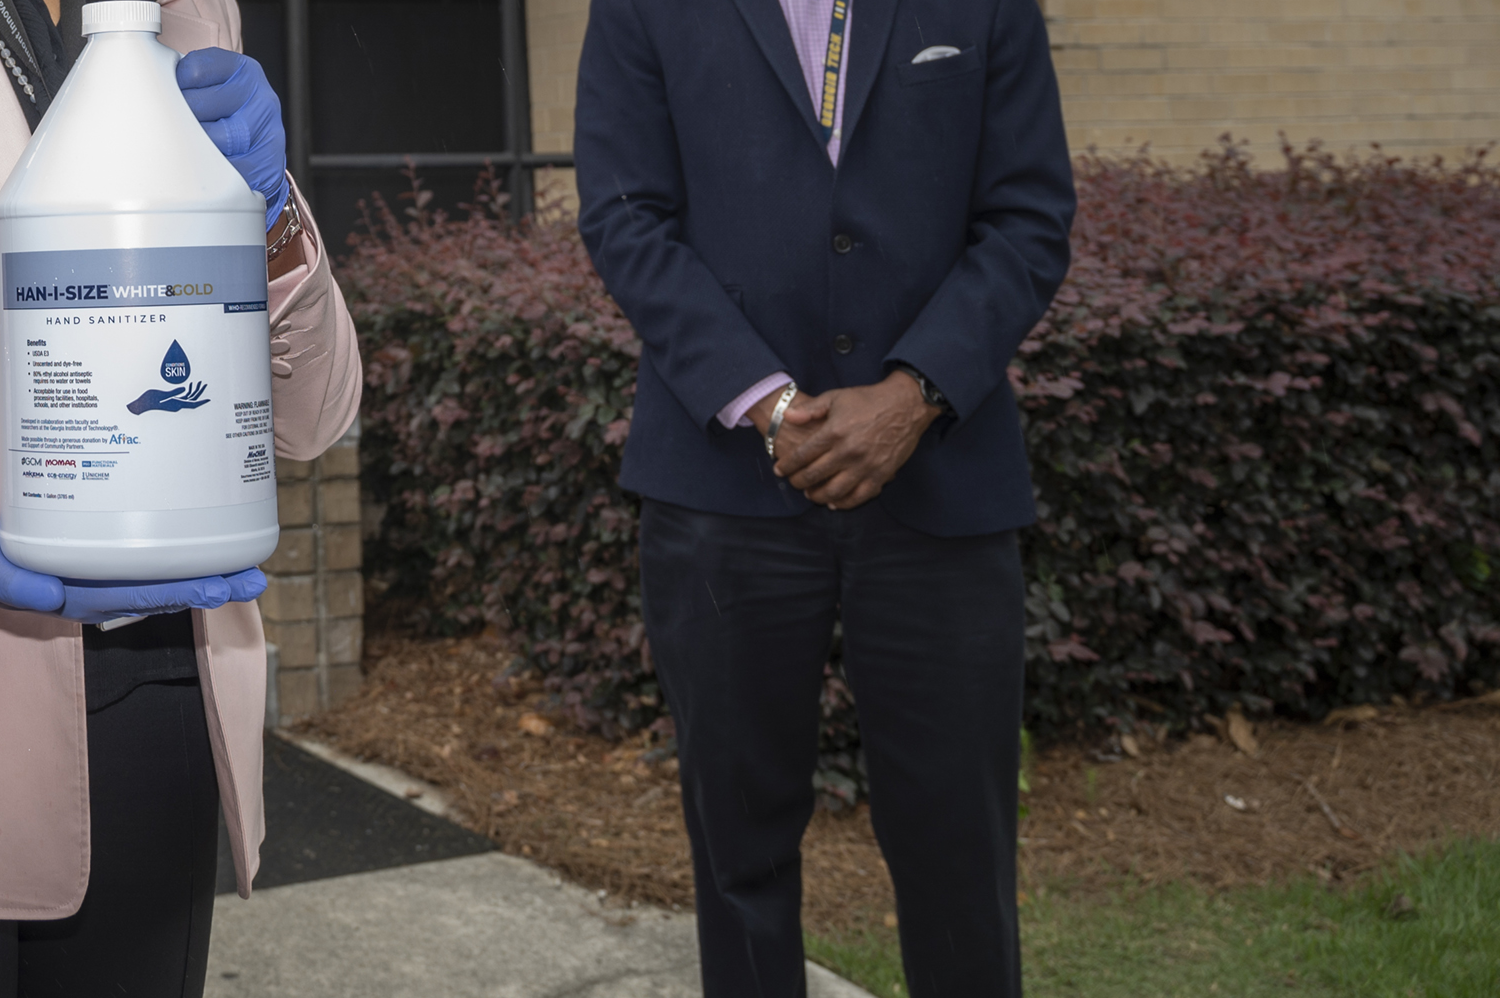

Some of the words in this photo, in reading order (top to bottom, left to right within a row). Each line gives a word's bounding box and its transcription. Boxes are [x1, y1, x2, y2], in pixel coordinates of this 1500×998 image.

[820, 71, 837, 127] GEORGIA
[46, 316, 81, 326] HAND
[88, 314, 167, 325] SANITIZER
[165, 367, 185, 377] SKIN
